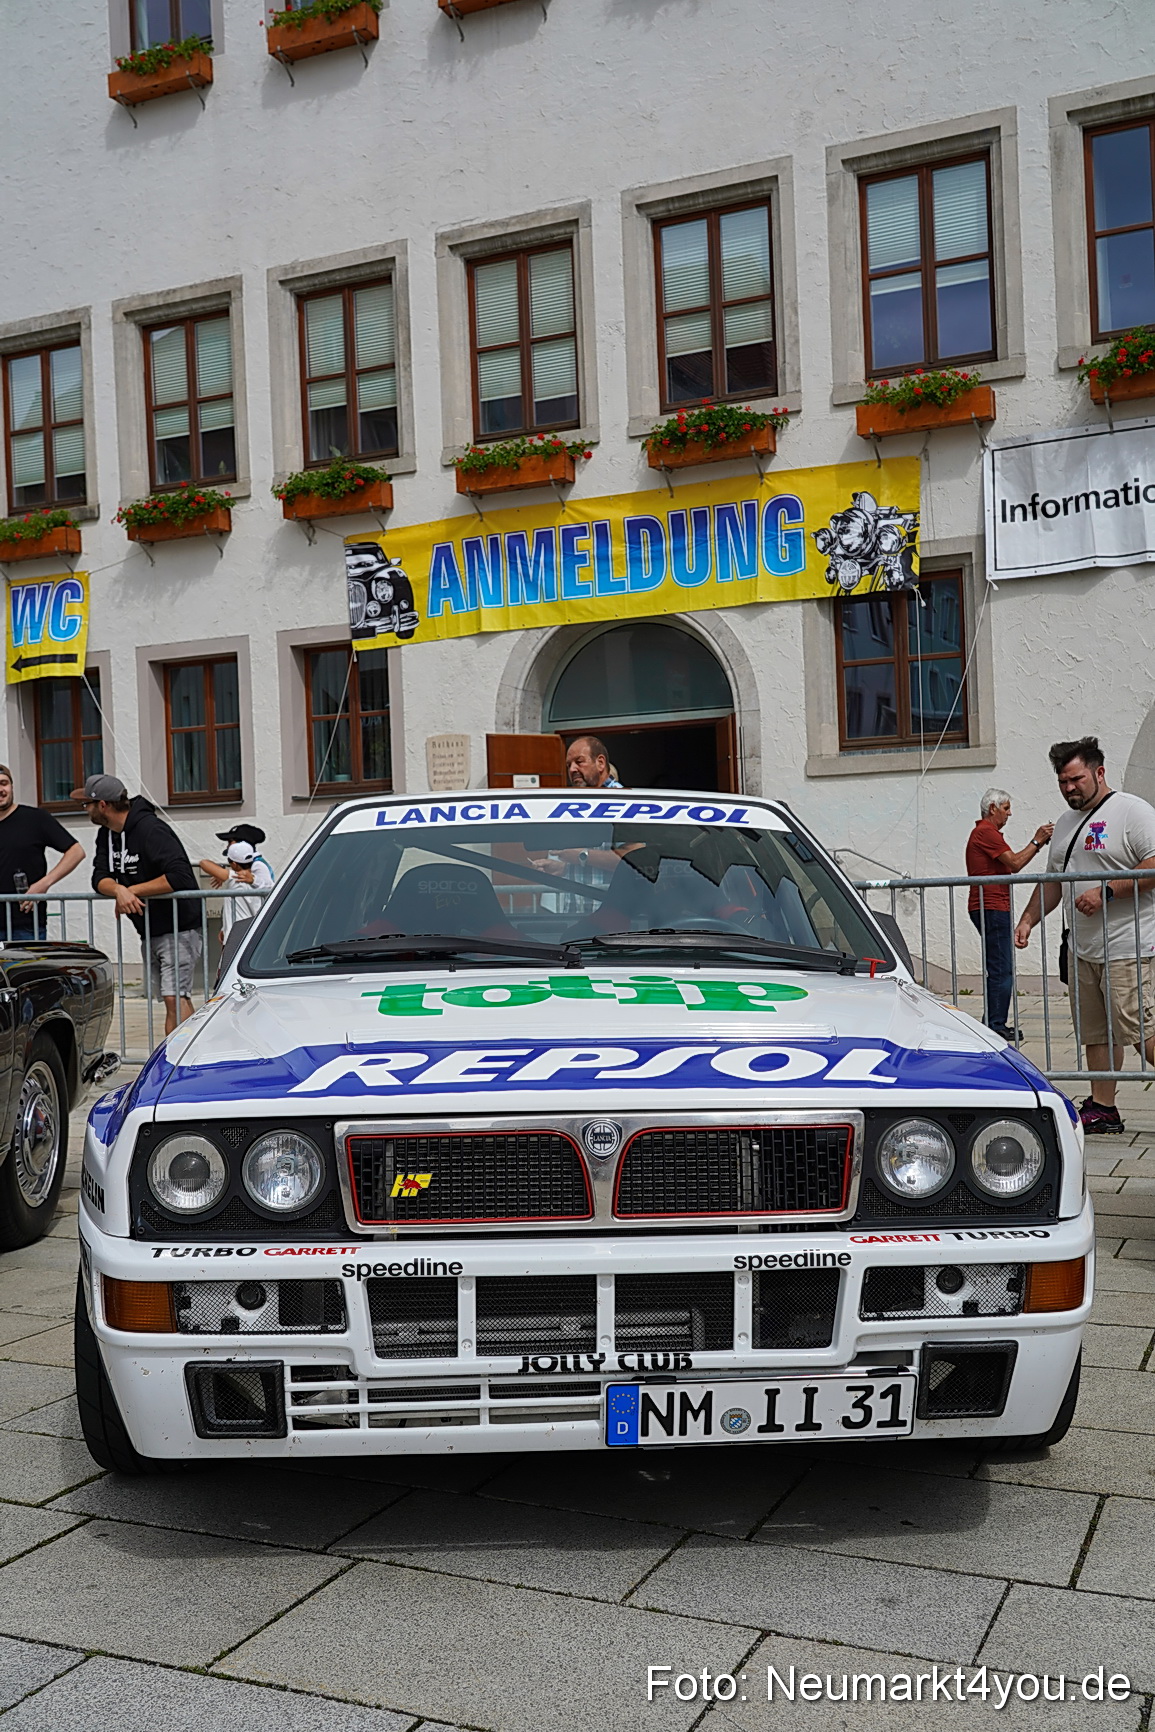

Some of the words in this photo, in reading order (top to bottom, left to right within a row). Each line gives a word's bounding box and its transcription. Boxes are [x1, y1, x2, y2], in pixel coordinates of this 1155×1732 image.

[427, 493, 806, 618] ANMELDUNG
[10, 578, 84, 648] WC
[375, 802, 531, 827] LANCIA
[547, 802, 751, 825] REPSOL
[417, 880, 478, 894] sparco
[361, 974, 809, 1017] totip
[286, 1045, 899, 1094] REPSOL
[390, 1173, 433, 1197] HF
[849, 1233, 942, 1244] GARRETT
[945, 1229, 1051, 1241] TURBO
[151, 1247, 257, 1258] TURBO
[263, 1246, 362, 1256] GARRETT
[733, 1249, 852, 1271] speedline
[342, 1258, 463, 1281] speedline
[518, 1352, 606, 1374] JOLLY
[618, 1352, 693, 1372] CLUB
[616, 1421, 629, 1434] D
[640, 1390, 713, 1437] NM
[841, 1383, 908, 1430] 31
